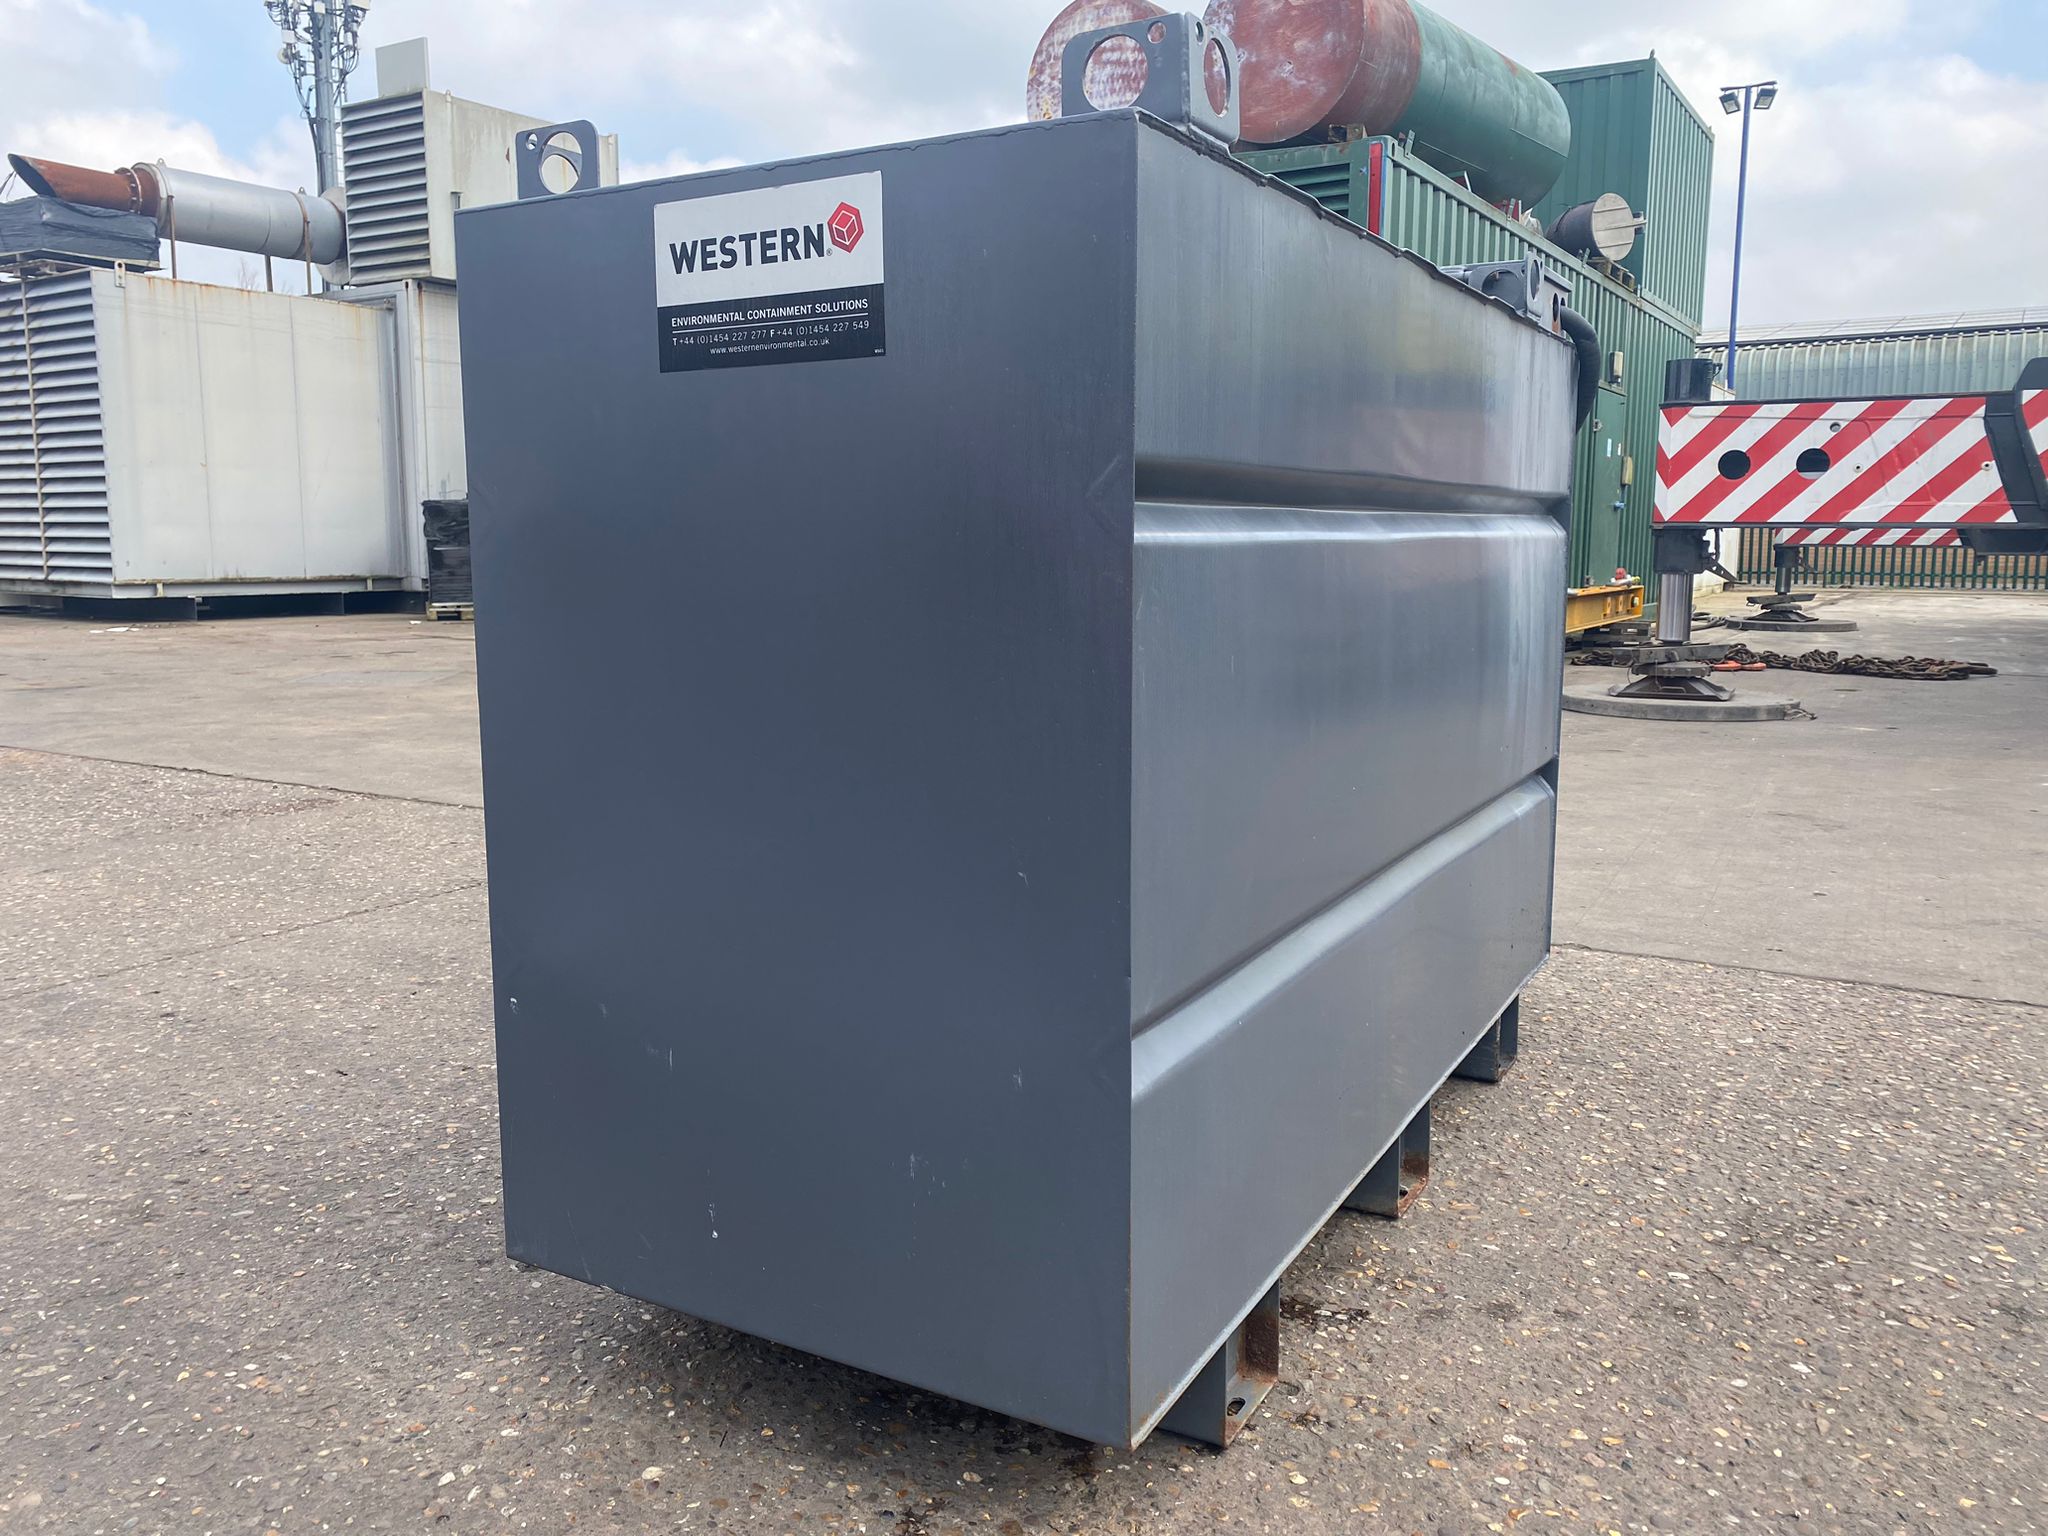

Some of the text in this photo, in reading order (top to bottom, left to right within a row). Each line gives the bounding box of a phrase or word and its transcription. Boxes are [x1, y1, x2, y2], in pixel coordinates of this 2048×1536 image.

[669, 223, 825, 275] WESTERN
[671, 298, 869, 327] ENVIRONMENTAL CONTAINMENT SOLUTIONS
[672, 320, 870, 346] T +44 (0)1454 227 277 F +44 (0)1454 227 549
[710, 336, 830, 355] www.westernenvironmental.co.uk
